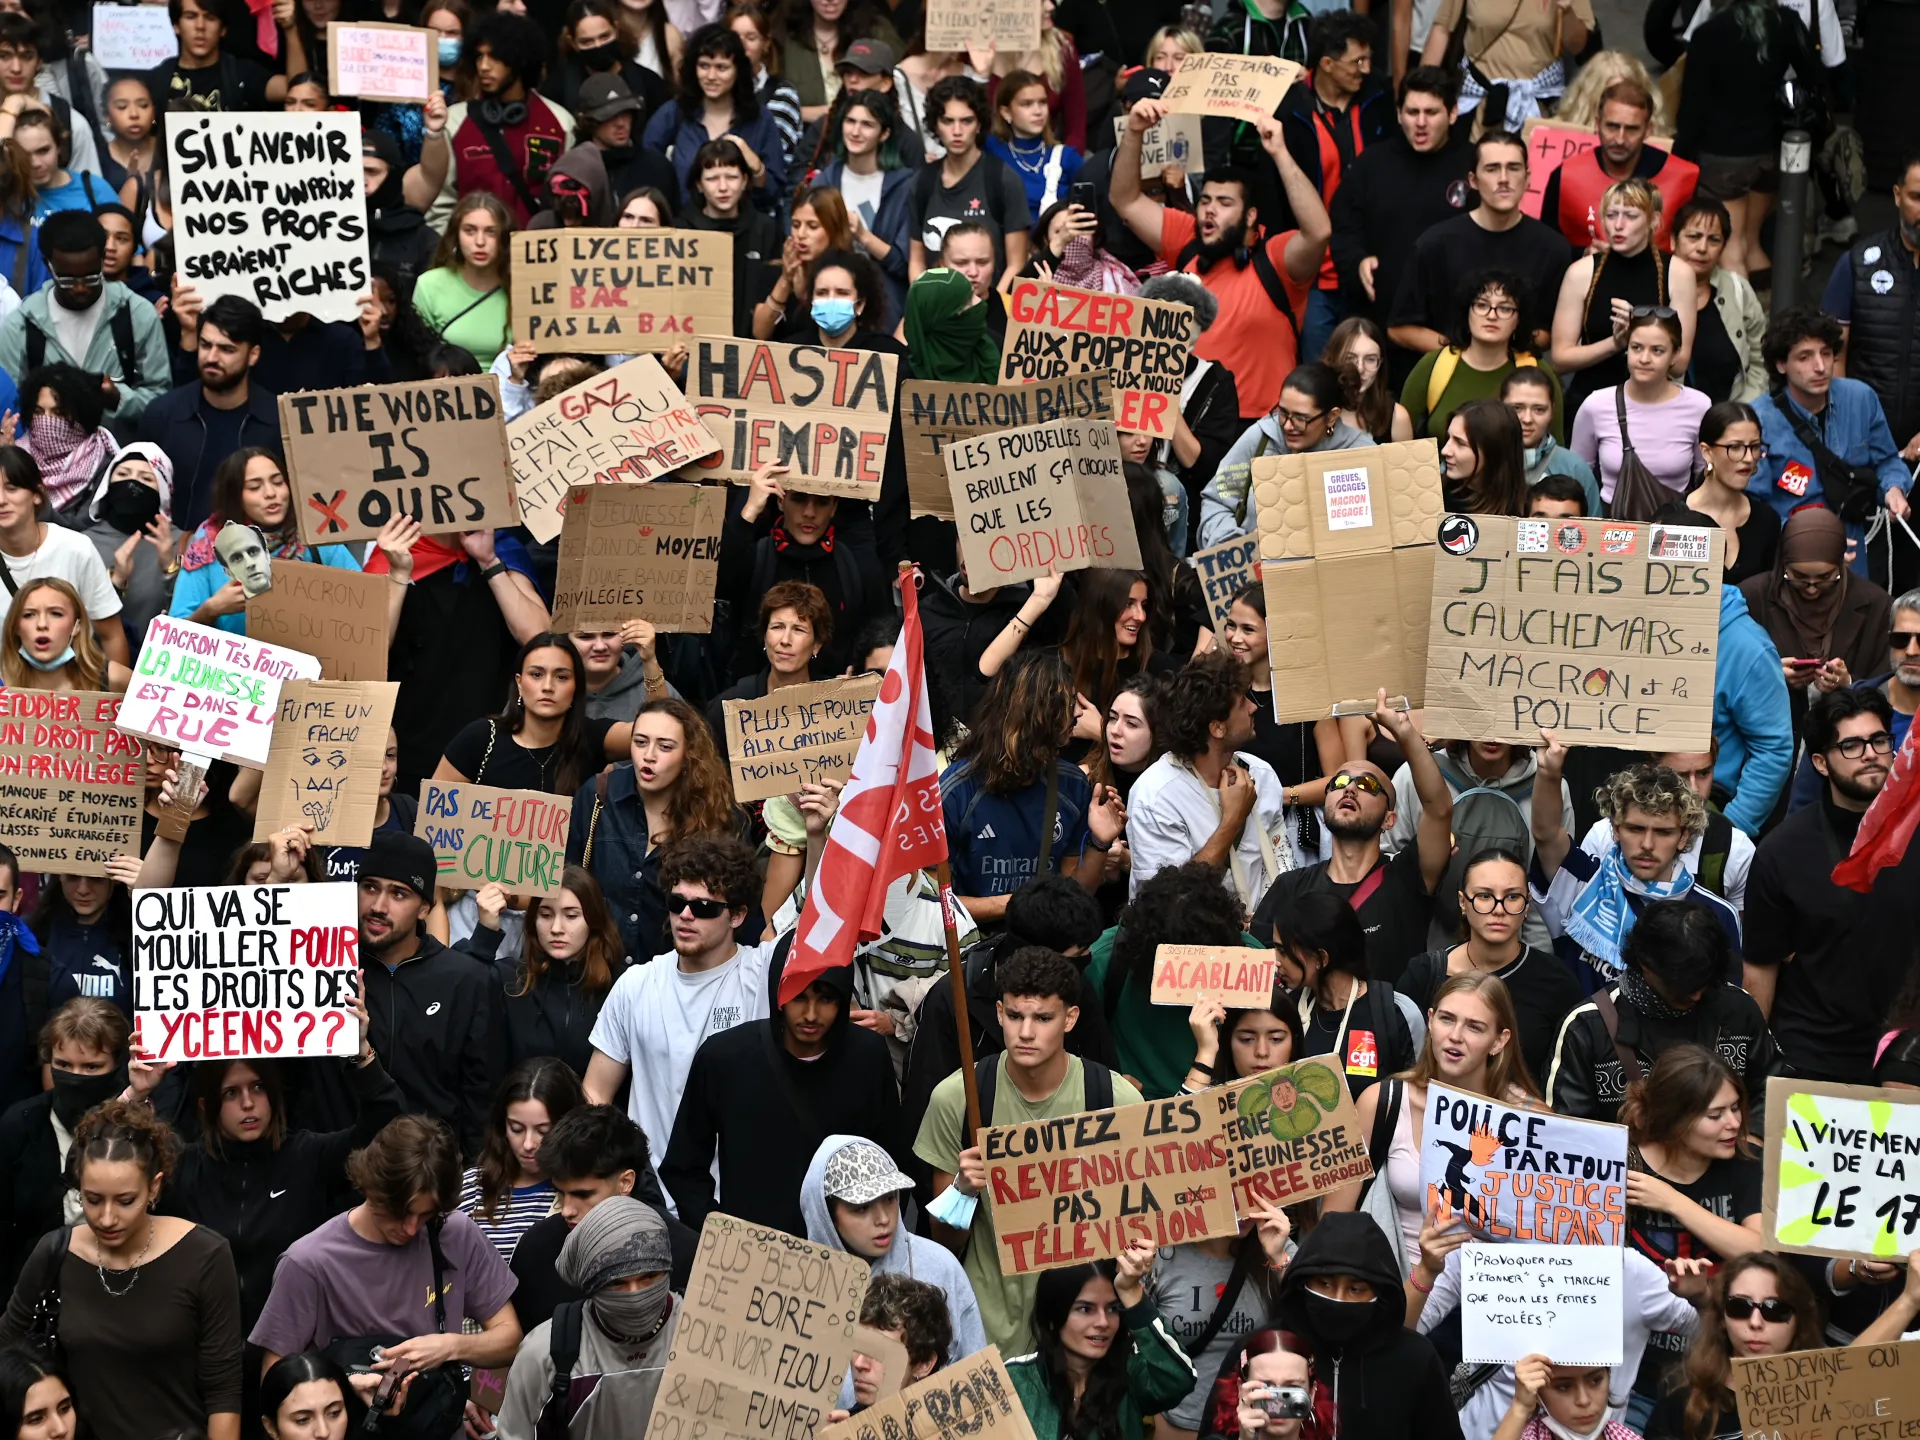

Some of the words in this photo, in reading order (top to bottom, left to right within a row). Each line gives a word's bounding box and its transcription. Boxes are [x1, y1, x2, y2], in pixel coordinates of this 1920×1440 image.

[1179, 54, 1234, 73] BAISE
[1211, 71, 1239, 87] PAS
[1164, 86, 1191, 99] LES
[181, 170, 269, 205] AVAIT
[275, 179, 308, 206] UN
[308, 169, 355, 201] PRIX
[185, 210, 249, 238] NOS
[262, 206, 365, 242] PROFS
[184, 243, 292, 280] SERAIENT
[525, 238, 558, 264] LES
[573, 237, 699, 261] LYCEENS
[253, 256, 367, 308] RICHES
[570, 264, 714, 288] VEULENT
[531, 282, 557, 305] LE
[570, 285, 628, 309] BAC
[1011, 282, 1134, 337] GAZER
[1141, 306, 1193, 342] NOUS
[529, 315, 577, 340] PAS
[587, 315, 621, 335] LA
[638, 312, 694, 334] BAC
[1014, 328, 1068, 359] AUX
[1071, 331, 1187, 376] POPPERS
[698, 341, 890, 414] HASTA
[1005, 353, 1069, 381] POUR
[1144, 375, 1183, 395] NOUS
[291, 393, 376, 435] THE
[378, 386, 496, 426] WORLD
[559, 377, 633, 420] GAZ
[911, 390, 1028, 427] MACRON
[1035, 374, 1111, 424] BAISE
[369, 427, 430, 483] IS
[526, 416, 595, 473] FAIT
[952, 441, 990, 472] LES
[998, 428, 1081, 460] POUBELLES
[1088, 427, 1111, 448] QUI
[518, 434, 644, 519] ATTISER
[965, 463, 1038, 504] BRULENT
[1050, 457, 1074, 484] ÇA
[1078, 458, 1120, 476] CHOQUE
[1327, 482, 1367, 495] BLOCAGES
[1781, 470, 1809, 491] cgt
[594, 499, 690, 527] JEUNESSE
[970, 507, 1006, 534] QUE
[1016, 497, 1053, 525] LES
[1330, 494, 1368, 507] MACRON
[562, 536, 622, 558] BESOIN
[627, 538, 648, 557] DE
[655, 534, 721, 563] MOYENS
[988, 524, 1115, 573] ORDURES
[1603, 530, 1635, 543] ACAB
[1663, 549, 1679, 557] NOS
[1682, 549, 1706, 558] VILLES
[1674, 541, 1694, 550] HORS
[1697, 542, 1707, 550] DE
[1197, 540, 1256, 578] TROP
[271, 573, 366, 609] MACRON
[558, 568, 582, 587] PAS
[695, 569, 714, 587] DE
[1645, 561, 1710, 596] DES
[555, 583, 645, 611] PRIVILÉGIÉS
[250, 604, 289, 633] PAS
[299, 613, 323, 639] DU
[330, 618, 381, 645] TOUT
[1442, 601, 1685, 656] CAUCHEMARS
[1690, 641, 1711, 655] de
[150, 618, 220, 657] MACRON
[252, 647, 299, 680] FOUTU
[139, 646, 171, 678] LA
[171, 654, 266, 707] JEUNESSE
[1458, 651, 1631, 699] MACRON
[136, 682, 176, 703] EST
[183, 691, 239, 716] DANS
[281, 698, 335, 722] FUME
[345, 703, 373, 719] UN
[1512, 694, 1660, 736] POLICE
[147, 705, 239, 747] RUE
[308, 724, 360, 743] FACHO
[738, 704, 790, 736] PLUS
[798, 702, 823, 730] DE
[34, 723, 100, 753] DROIT
[103, 727, 143, 759] PAS
[779, 727, 847, 751] CANTINE
[27, 751, 141, 786] PRIVILÈGE
[741, 761, 799, 782] MOINS
[802, 755, 844, 773] DANS
[0, 784, 48, 800] MANQUE
[58, 789, 76, 803] DE
[81, 791, 137, 809] MOYENS
[0, 823, 41, 837] LASSES
[49, 826, 130, 845] SURCHARGÉES
[67, 806, 137, 827] ÉTUDIANTE
[425, 786, 460, 819] PAS
[470, 799, 493, 820] DE
[491, 796, 570, 848] FUTUR
[425, 825, 465, 852] SANS
[463, 833, 565, 892] CULTURE
[981, 854, 1055, 875] Emirats
[135, 887, 196, 931] QUI
[206, 889, 247, 928] VA
[253, 887, 291, 926] SE
[134, 930, 281, 972] MOUILLER
[289, 925, 359, 968] POUR
[1164, 946, 1208, 956] SYSTEME
[134, 973, 190, 1012] LES
[201, 968, 305, 1010] DROITS
[314, 969, 358, 1009] DES
[1156, 960, 1275, 993] ACABLANT
[713, 1006, 741, 1016] LONELY
[713, 1013, 741, 1023] HEARTS
[713, 1021, 732, 1030] CLUB
[134, 1007, 284, 1061] LYCÉENS
[1350, 1050, 1376, 1067] cgt
[986, 1112, 1121, 1161] ÉCOUTEZ
[1142, 1099, 1202, 1138] LES
[1434, 1095, 1546, 1151] POLICE
[1237, 1124, 1349, 1173] JEUNESSE
[1309, 1142, 1366, 1172] COMME
[1504, 1148, 1626, 1183] PARTOUT
[990, 1133, 1228, 1206] REVENDICATIONS
[1311, 1158, 1374, 1191] BARDELLA
[1833, 1152, 1862, 1174] DE
[1875, 1158, 1906, 1182] LA
[1053, 1189, 1102, 1225] PAS
[1119, 1181, 1162, 1217] LA
[1480, 1171, 1622, 1213] JUSTICE
[1811, 1181, 1862, 1228] LE
[1002, 1205, 1209, 1273] TÉLÉVISION
[698, 1229, 753, 1274] PLUS
[760, 1247, 849, 1303] BESOIN
[1548, 1256, 1573, 1266] PUIS
[1538, 1273, 1554, 1288] ÇA
[1564, 1275, 1611, 1287] MARCHE
[698, 1272, 739, 1314] DE
[745, 1285, 827, 1340] BOIRE
[1467, 1293, 1489, 1305] QUE
[1497, 1293, 1527, 1305] POUR
[1531, 1295, 1549, 1305] LES
[1556, 1293, 1597, 1305] FEMMES
[1486, 1310, 1543, 1326] VIOLÉES
[674, 1311, 727, 1363] POUR
[732, 1328, 773, 1378] VOIR
[774, 1343, 832, 1394] FLOU
[1738, 1358, 1779, 1386] T'AS
[1784, 1348, 1853, 1382] DEVINÉ
[1868, 1344, 1900, 1369] QUI
[696, 1376, 739, 1421] DE
[745, 1389, 821, 1440] FUMER
[1749, 1402, 1807, 1428] C'EST
[1811, 1403, 1832, 1423] LA
